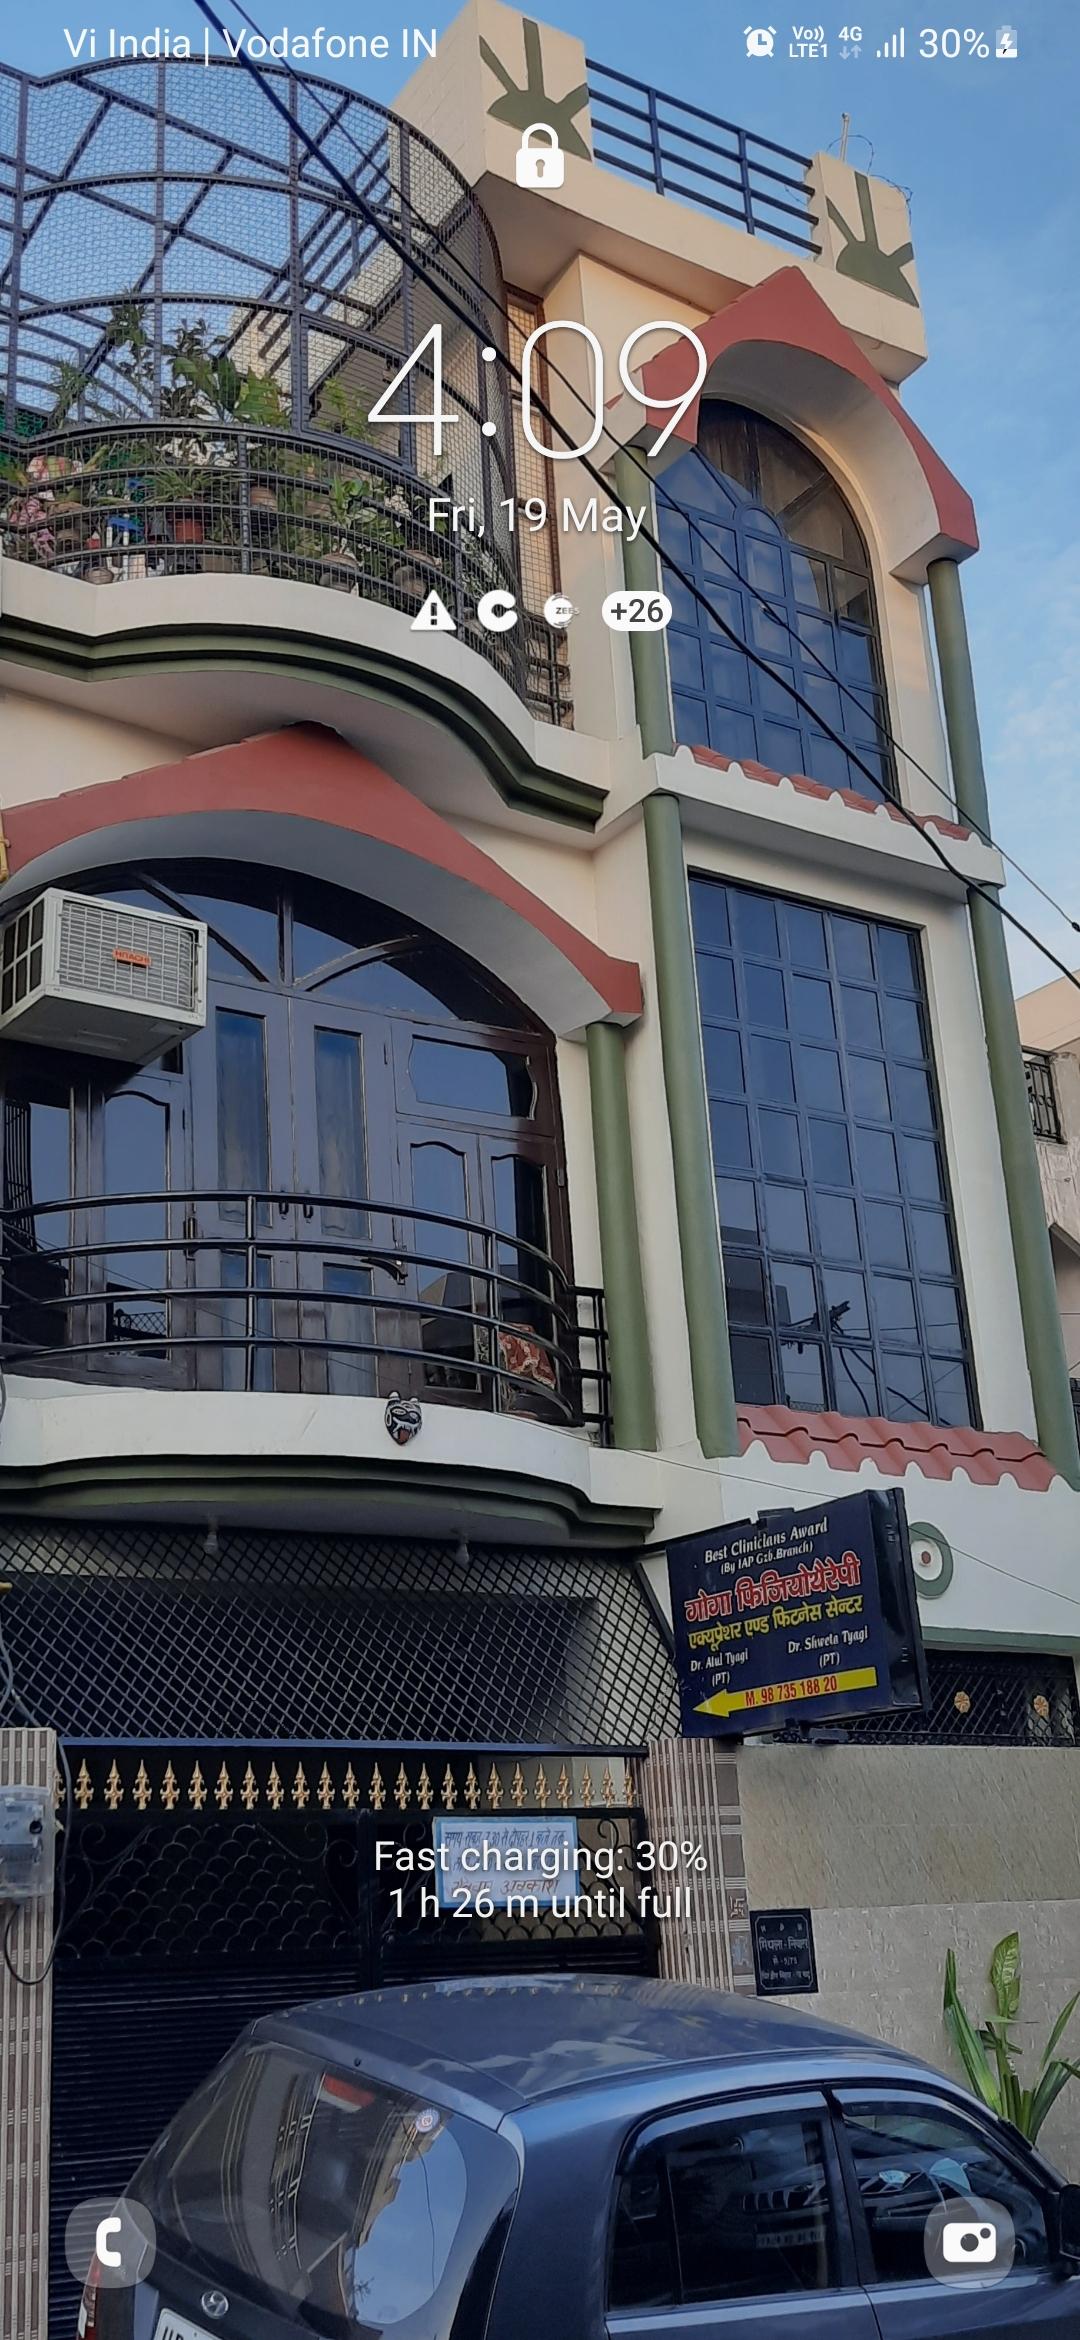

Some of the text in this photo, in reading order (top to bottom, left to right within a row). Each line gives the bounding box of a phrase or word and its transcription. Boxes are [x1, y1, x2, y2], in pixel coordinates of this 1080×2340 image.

[704, 1517, 828, 1564] Best Clinicians Award
[720, 1562, 735, 1575] (By
[738, 1556, 754, 1570] IAP
[683, 1550, 862, 1622] गोगा फिजियोथेरेपी
[688, 1595, 863, 1652] एक्यूप्रेशर एण्ड फिटनेस सेन्टर
[788, 1625, 868, 1654] Dr. Shweta Tyagi
[690, 1660, 704, 1672] Dr.
[726, 1648, 749, 1666] Tyagi
[819, 1652, 840, 1669] (PT)
[711, 1671, 730, 1687] (PT)
[745, 1676, 838, 1707] M. 98 735 188 20
